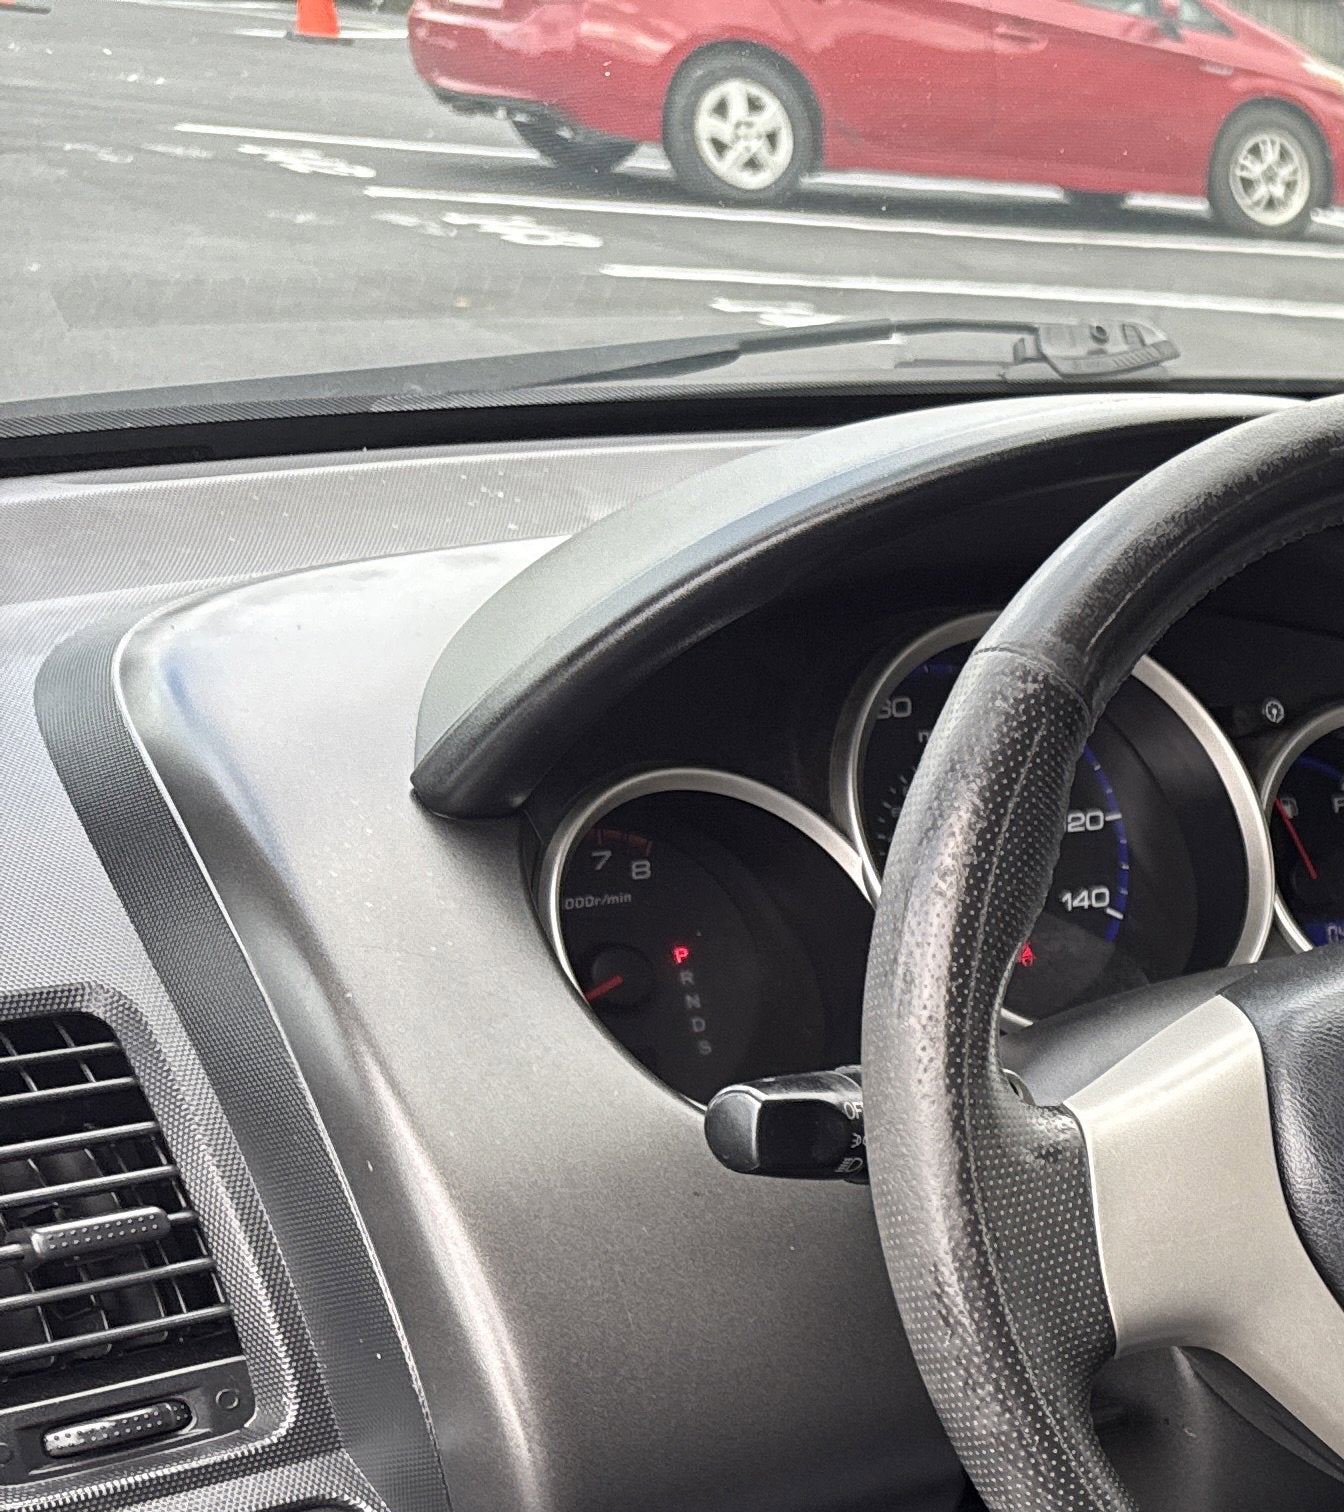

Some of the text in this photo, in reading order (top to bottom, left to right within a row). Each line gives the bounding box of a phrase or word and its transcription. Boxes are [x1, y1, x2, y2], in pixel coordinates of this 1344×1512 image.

[1066, 810, 1105, 833] 20
[591, 849, 613, 872] 7
[630, 859, 653, 881] 8
[563, 894, 633, 911] 000r/min
[1062, 886, 1111, 913] 140
[673, 944, 713, 1055] P R N D S
[844, 1101, 864, 1120] OF
